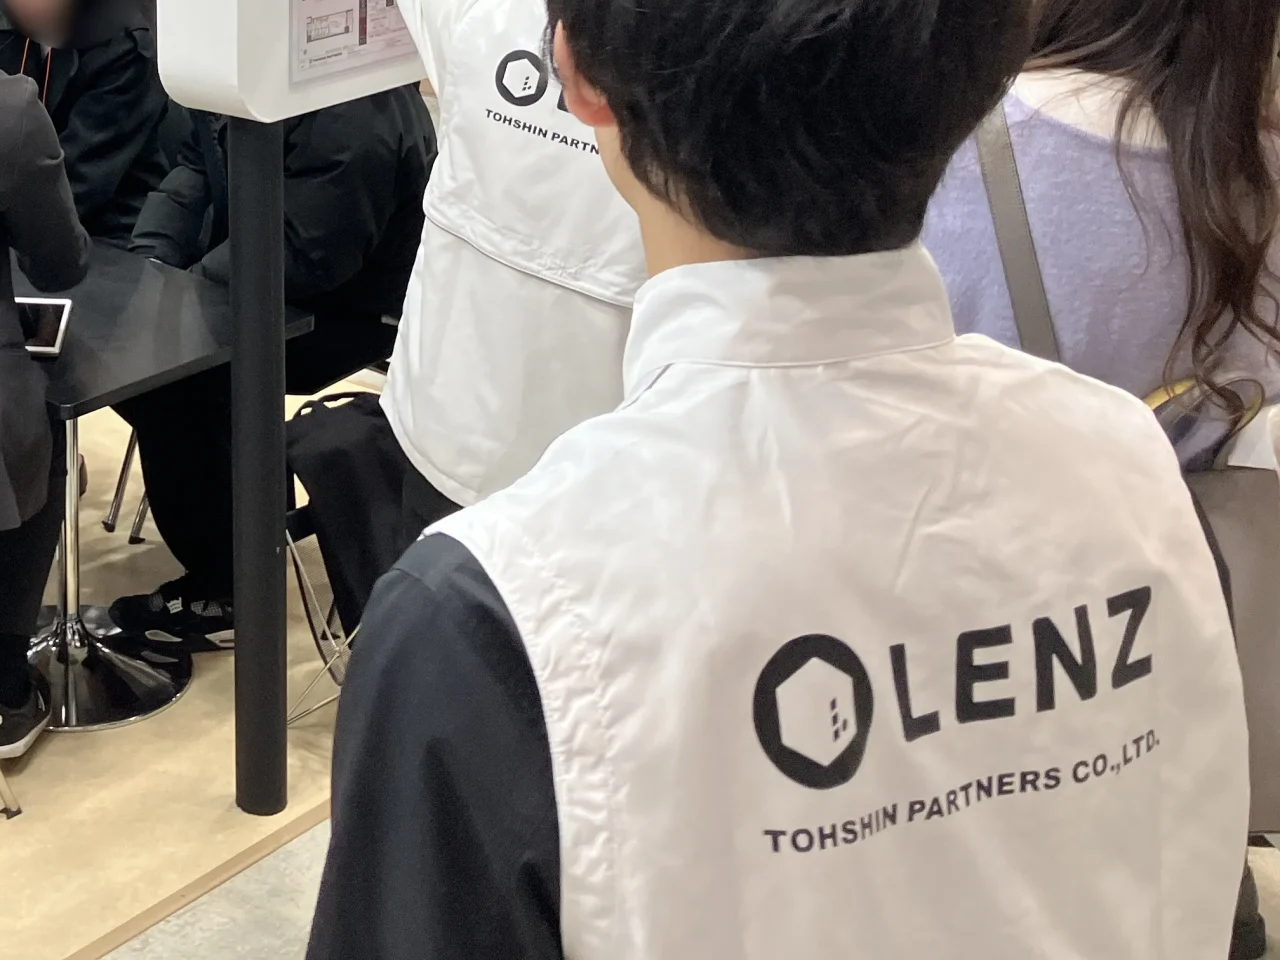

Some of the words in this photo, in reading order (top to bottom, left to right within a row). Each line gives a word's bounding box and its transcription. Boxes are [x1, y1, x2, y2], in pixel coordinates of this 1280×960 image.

[485, 108, 549, 139] TOHSHIN
[888, 585, 1153, 743] LENZ
[762, 803, 899, 854] TOHSHIN
[905, 766, 1062, 824] PARTNERS
